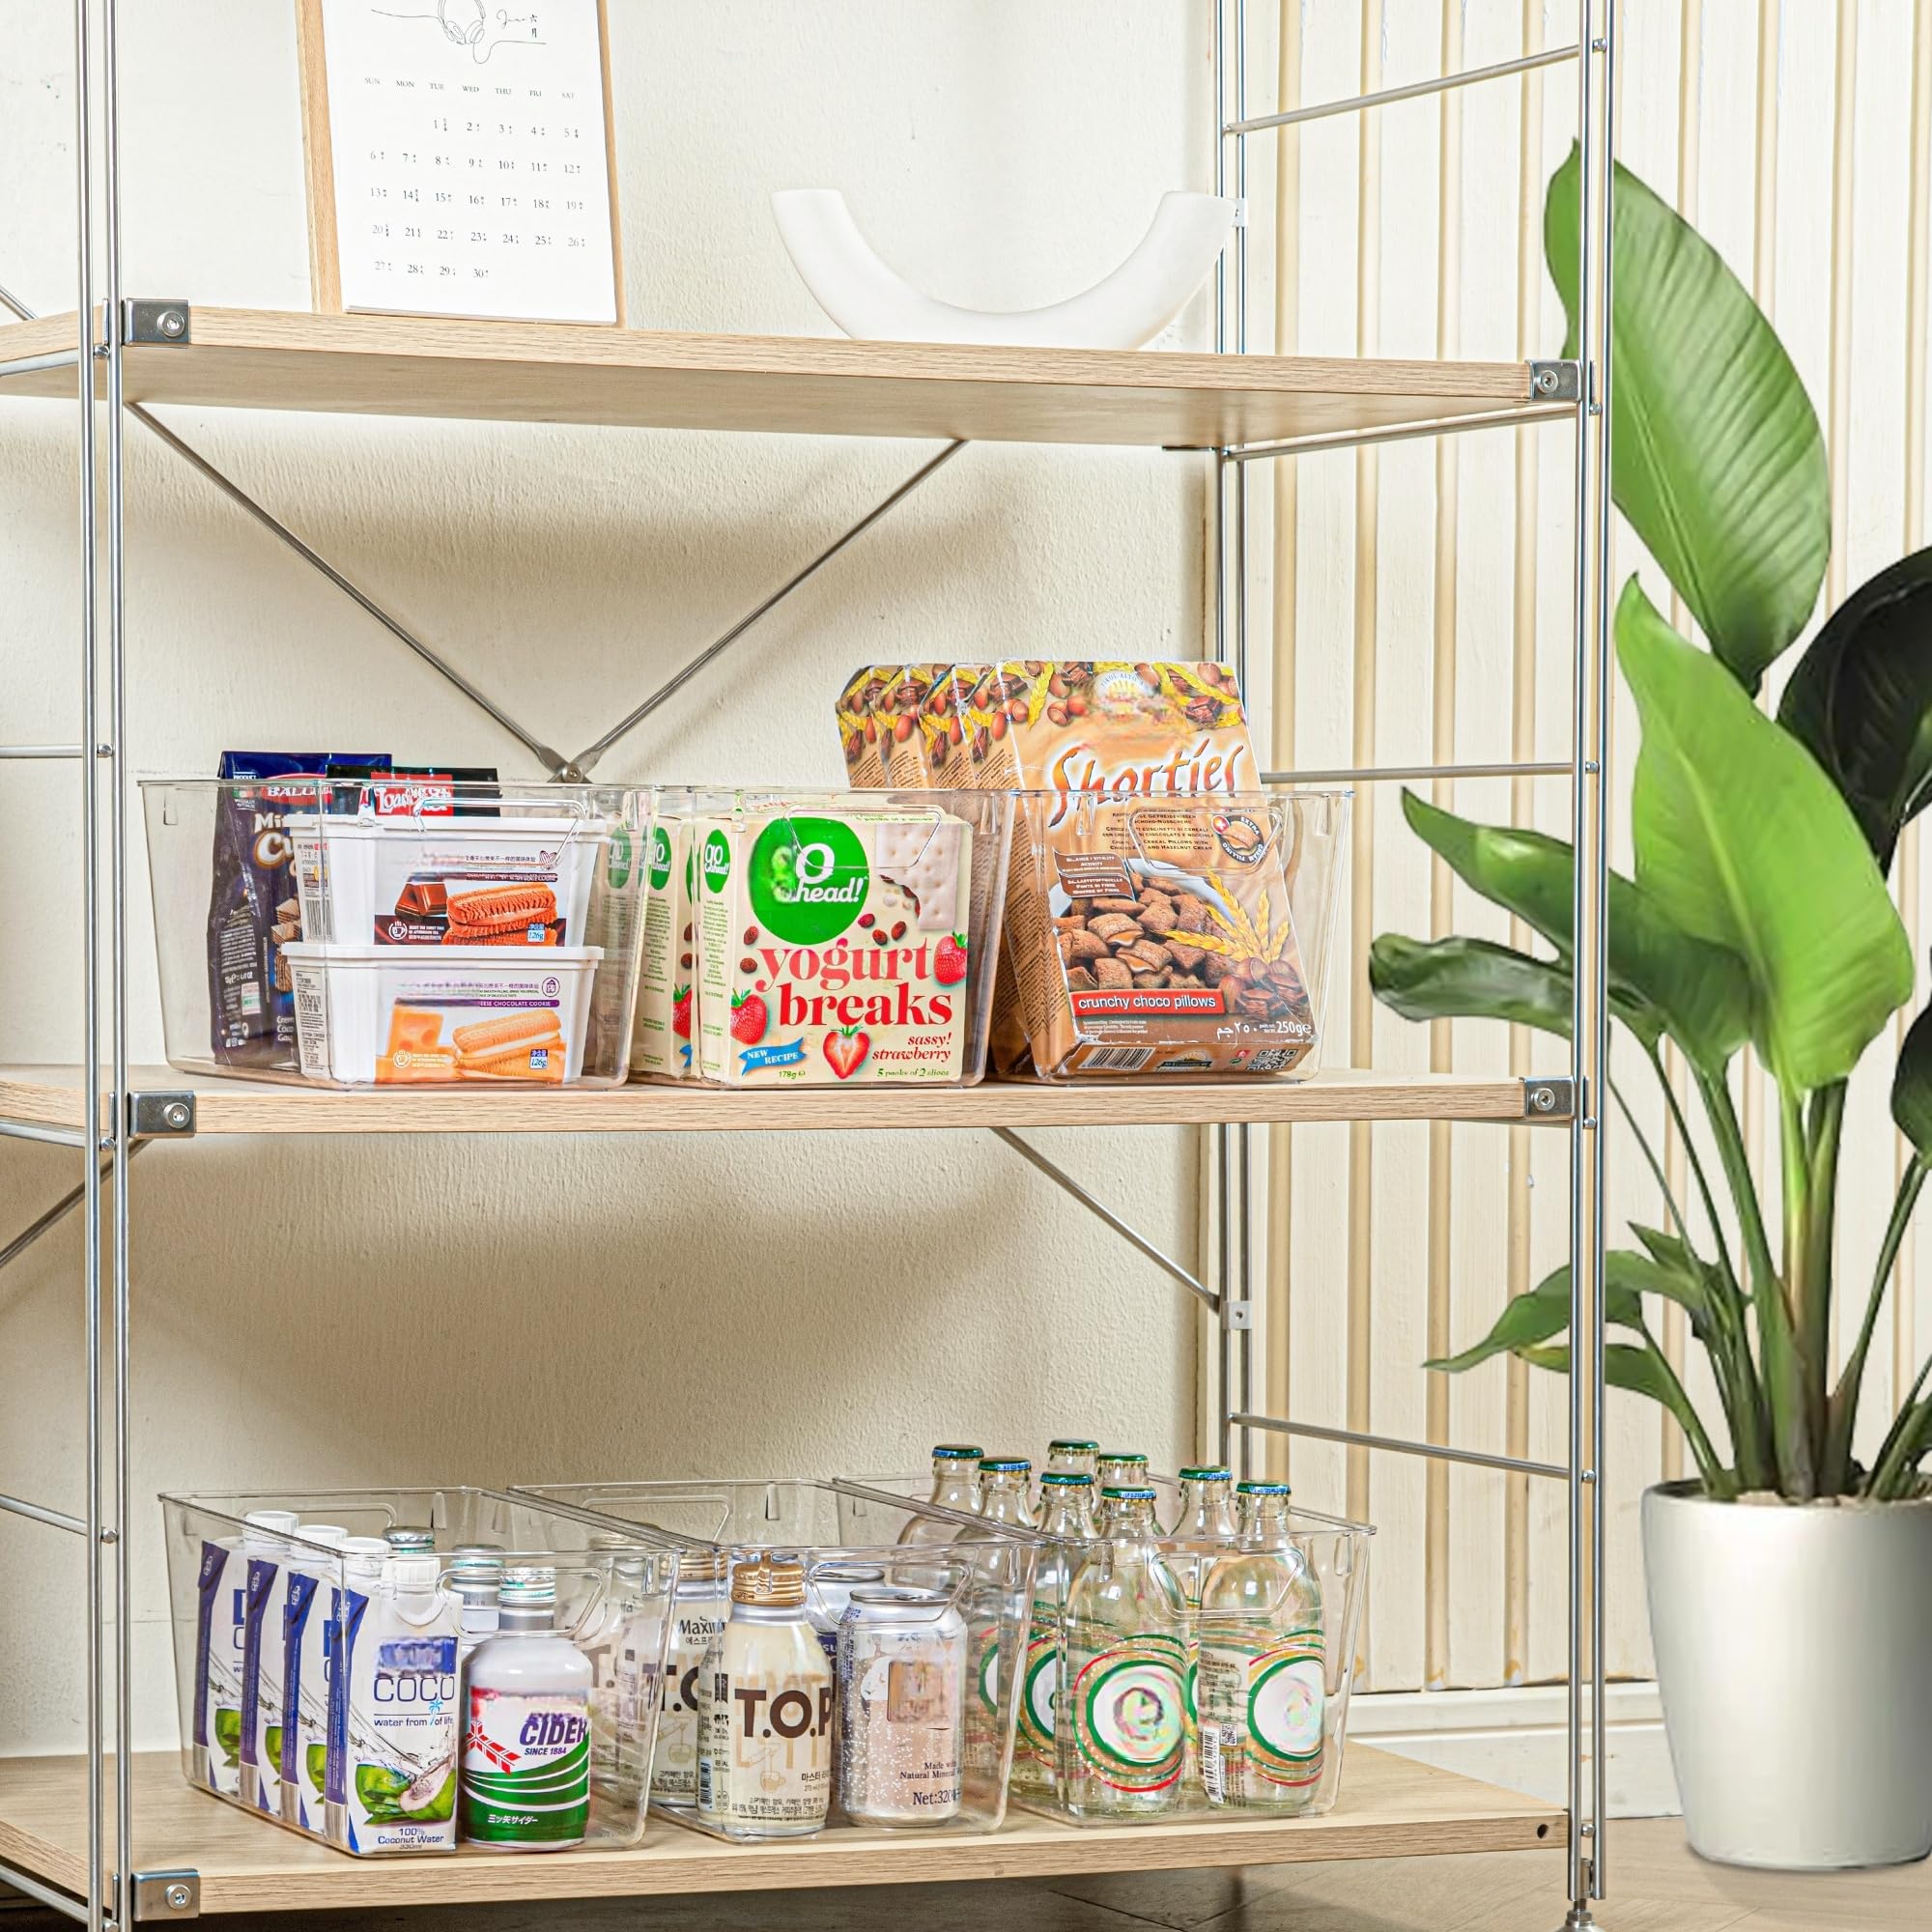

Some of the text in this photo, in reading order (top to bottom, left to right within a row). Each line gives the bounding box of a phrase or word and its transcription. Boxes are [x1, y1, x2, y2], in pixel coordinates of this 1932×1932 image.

[434, 119, 570, 137] 1 2 3 4 5
[370, 151, 574, 173] 6 7 8 9 10 11 12
[371, 187, 577, 210] 13 14 15 16 17 18 19
[373, 225, 579, 246] 20 21 22 23 24 25 26
[375, 261, 484, 278] 27 28 29 30
[1240, 816, 1261, 836] EXTRA
[788, 876, 866, 903] head!
[755, 937, 932, 993] yogurt
[776, 981, 953, 1026] breaks
[1078, 994, 1216, 1009] crunchy choco pillows
[908, 1032, 952, 1047] sassy!
[747, 1049, 769, 1060] NEW
[764, 1052, 799, 1065] RECIPE
[872, 1046, 952, 1062] strawberry
[531, 1058, 547, 1067] 126g
[779, 1070, 797, 1079] 178g
[374, 1676, 455, 1702] COCO
[406, 1718, 427, 1726] from
[435, 1717, 442, 1725] of
[550, 1747, 567, 1755] 1884
[801, 1772, 820, 1782] 마스터
[931, 1770, 955, 1778] Mineral
[913, 1788, 959, 1805] Net:320
[487, 1813, 538, 1825] 三ツ矢サイダー
[378, 1835, 414, 1844] Coconut
[399, 1828, 425, 1836] 100%
